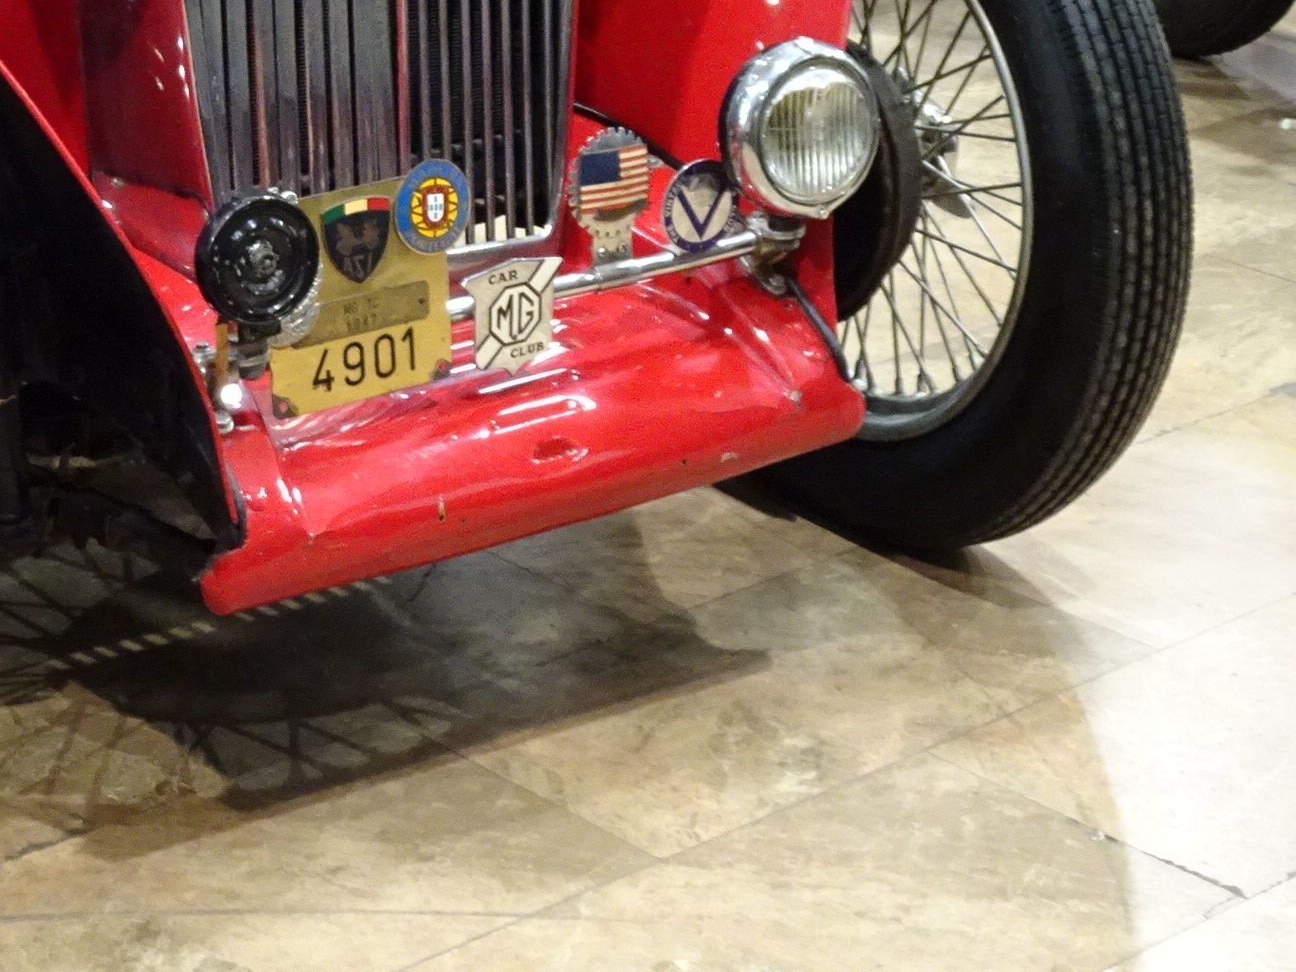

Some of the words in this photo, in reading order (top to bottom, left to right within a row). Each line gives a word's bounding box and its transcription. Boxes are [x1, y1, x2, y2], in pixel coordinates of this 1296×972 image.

[488, 269, 518, 286] CAR
[497, 291, 535, 341] MG
[312, 327, 415, 392] 4901
[510, 341, 545, 359] CLUB
